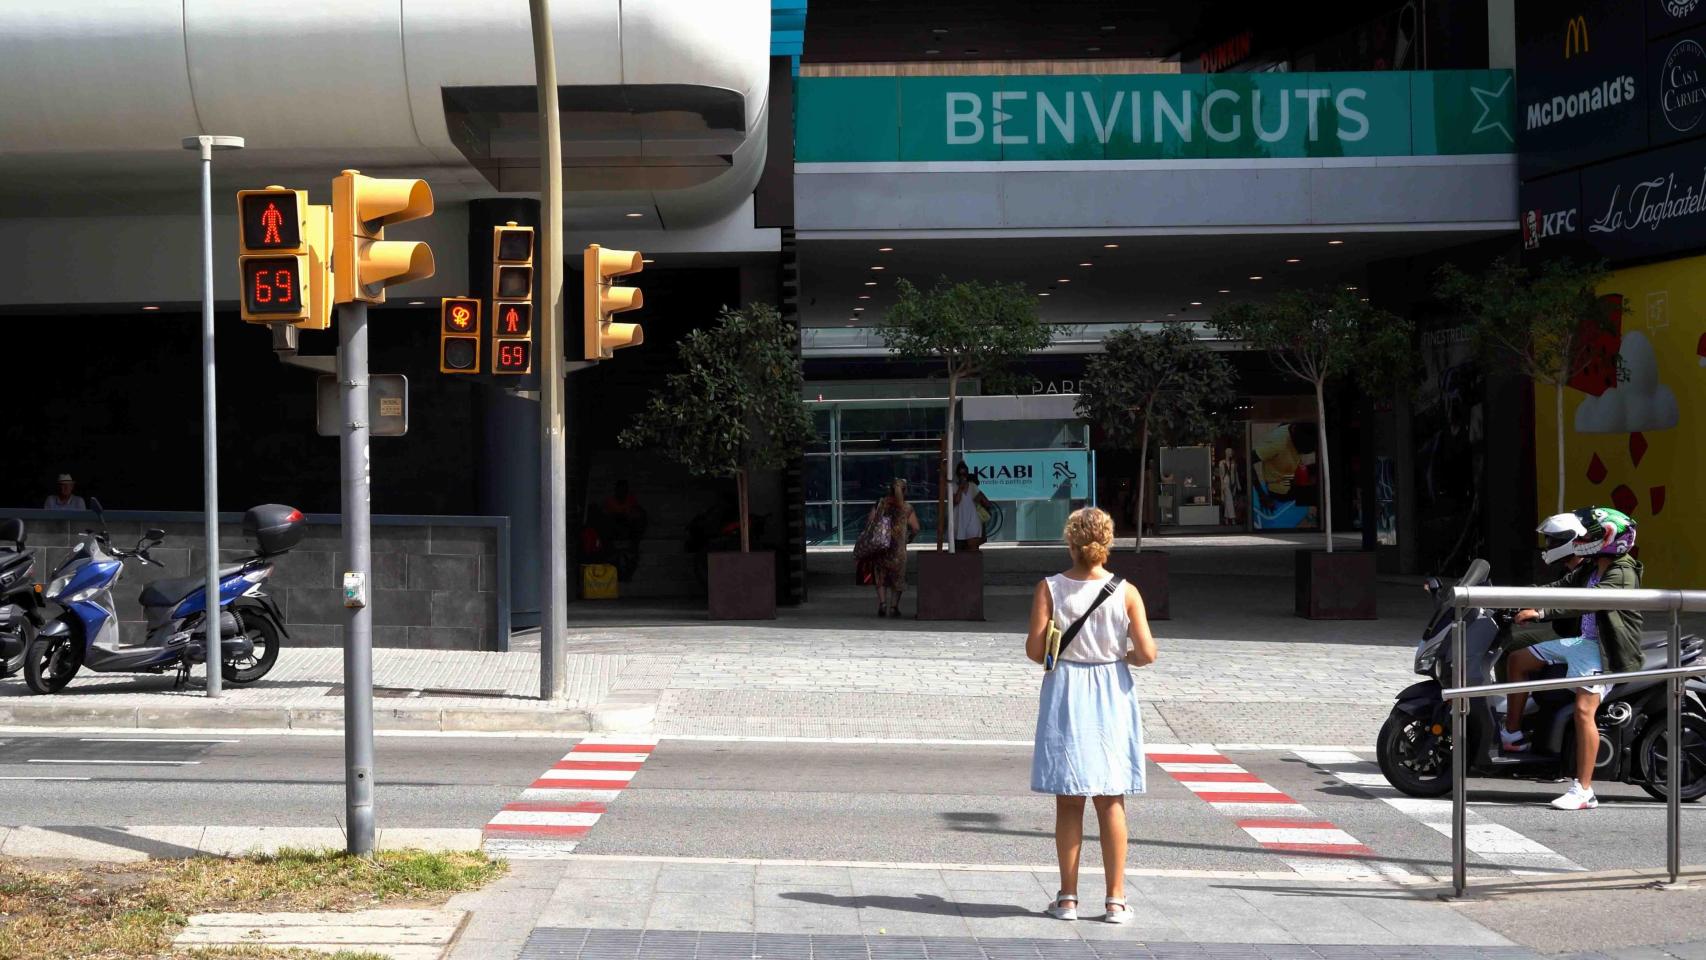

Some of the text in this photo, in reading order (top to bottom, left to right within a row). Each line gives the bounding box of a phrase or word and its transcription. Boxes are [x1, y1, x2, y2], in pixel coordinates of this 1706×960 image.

[945, 87, 1371, 145] BENVINGUTS
[1526, 75, 1636, 130] McDonald's
[1540, 208, 1577, 238] KFC
[1588, 184, 1623, 233] La
[256, 270, 291, 302] 69
[501, 346, 522, 366] 69
[973, 465, 1033, 479] KIABI
